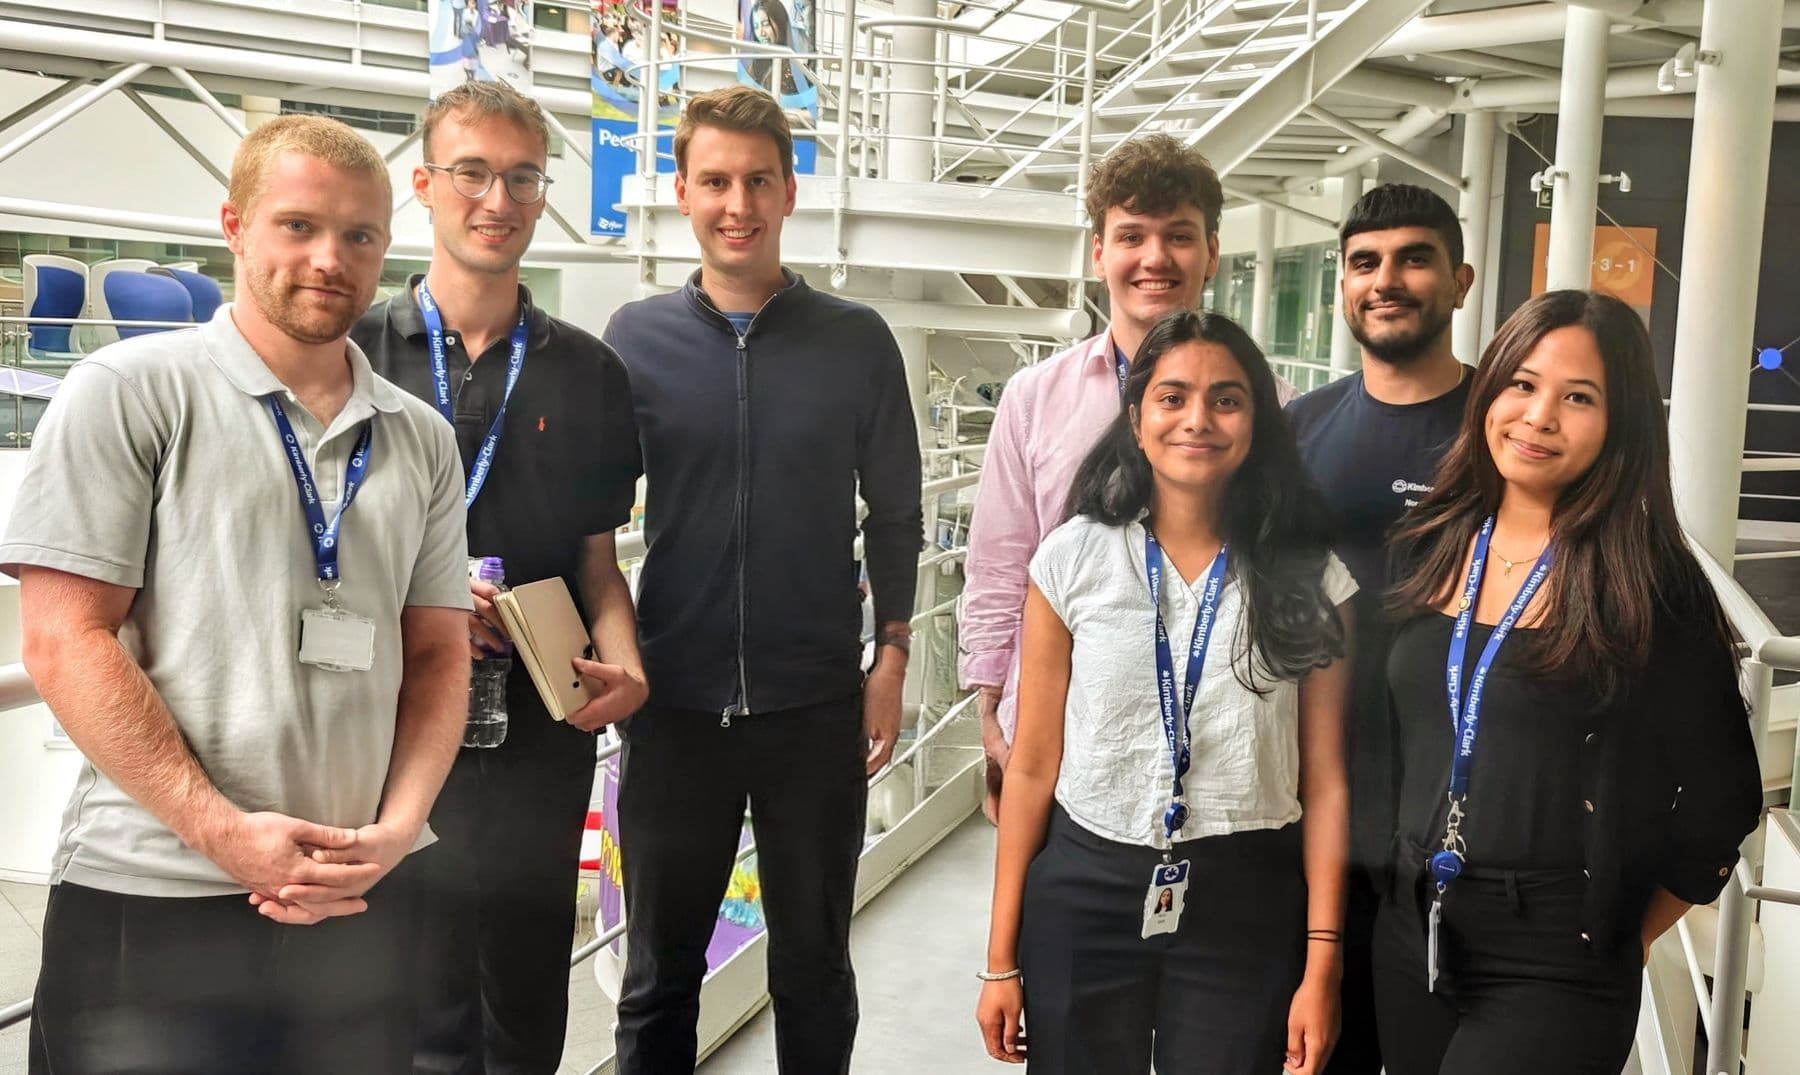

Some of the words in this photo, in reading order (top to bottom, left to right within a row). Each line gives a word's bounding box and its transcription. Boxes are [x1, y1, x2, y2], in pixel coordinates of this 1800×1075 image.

[432, 337, 449, 405] Kimberly-Clark
[290, 446, 316, 504] Kimberly-Clark
[466, 434, 498, 498] Kimberly-Clark
[1193, 577, 1220, 650] Kimberly-Clark
[1459, 558, 1481, 630] Kimrly-Clark
[1494, 569, 1545, 640] Kimberly-Clark
[1460, 675, 1485, 757] Kimberly-Clark
